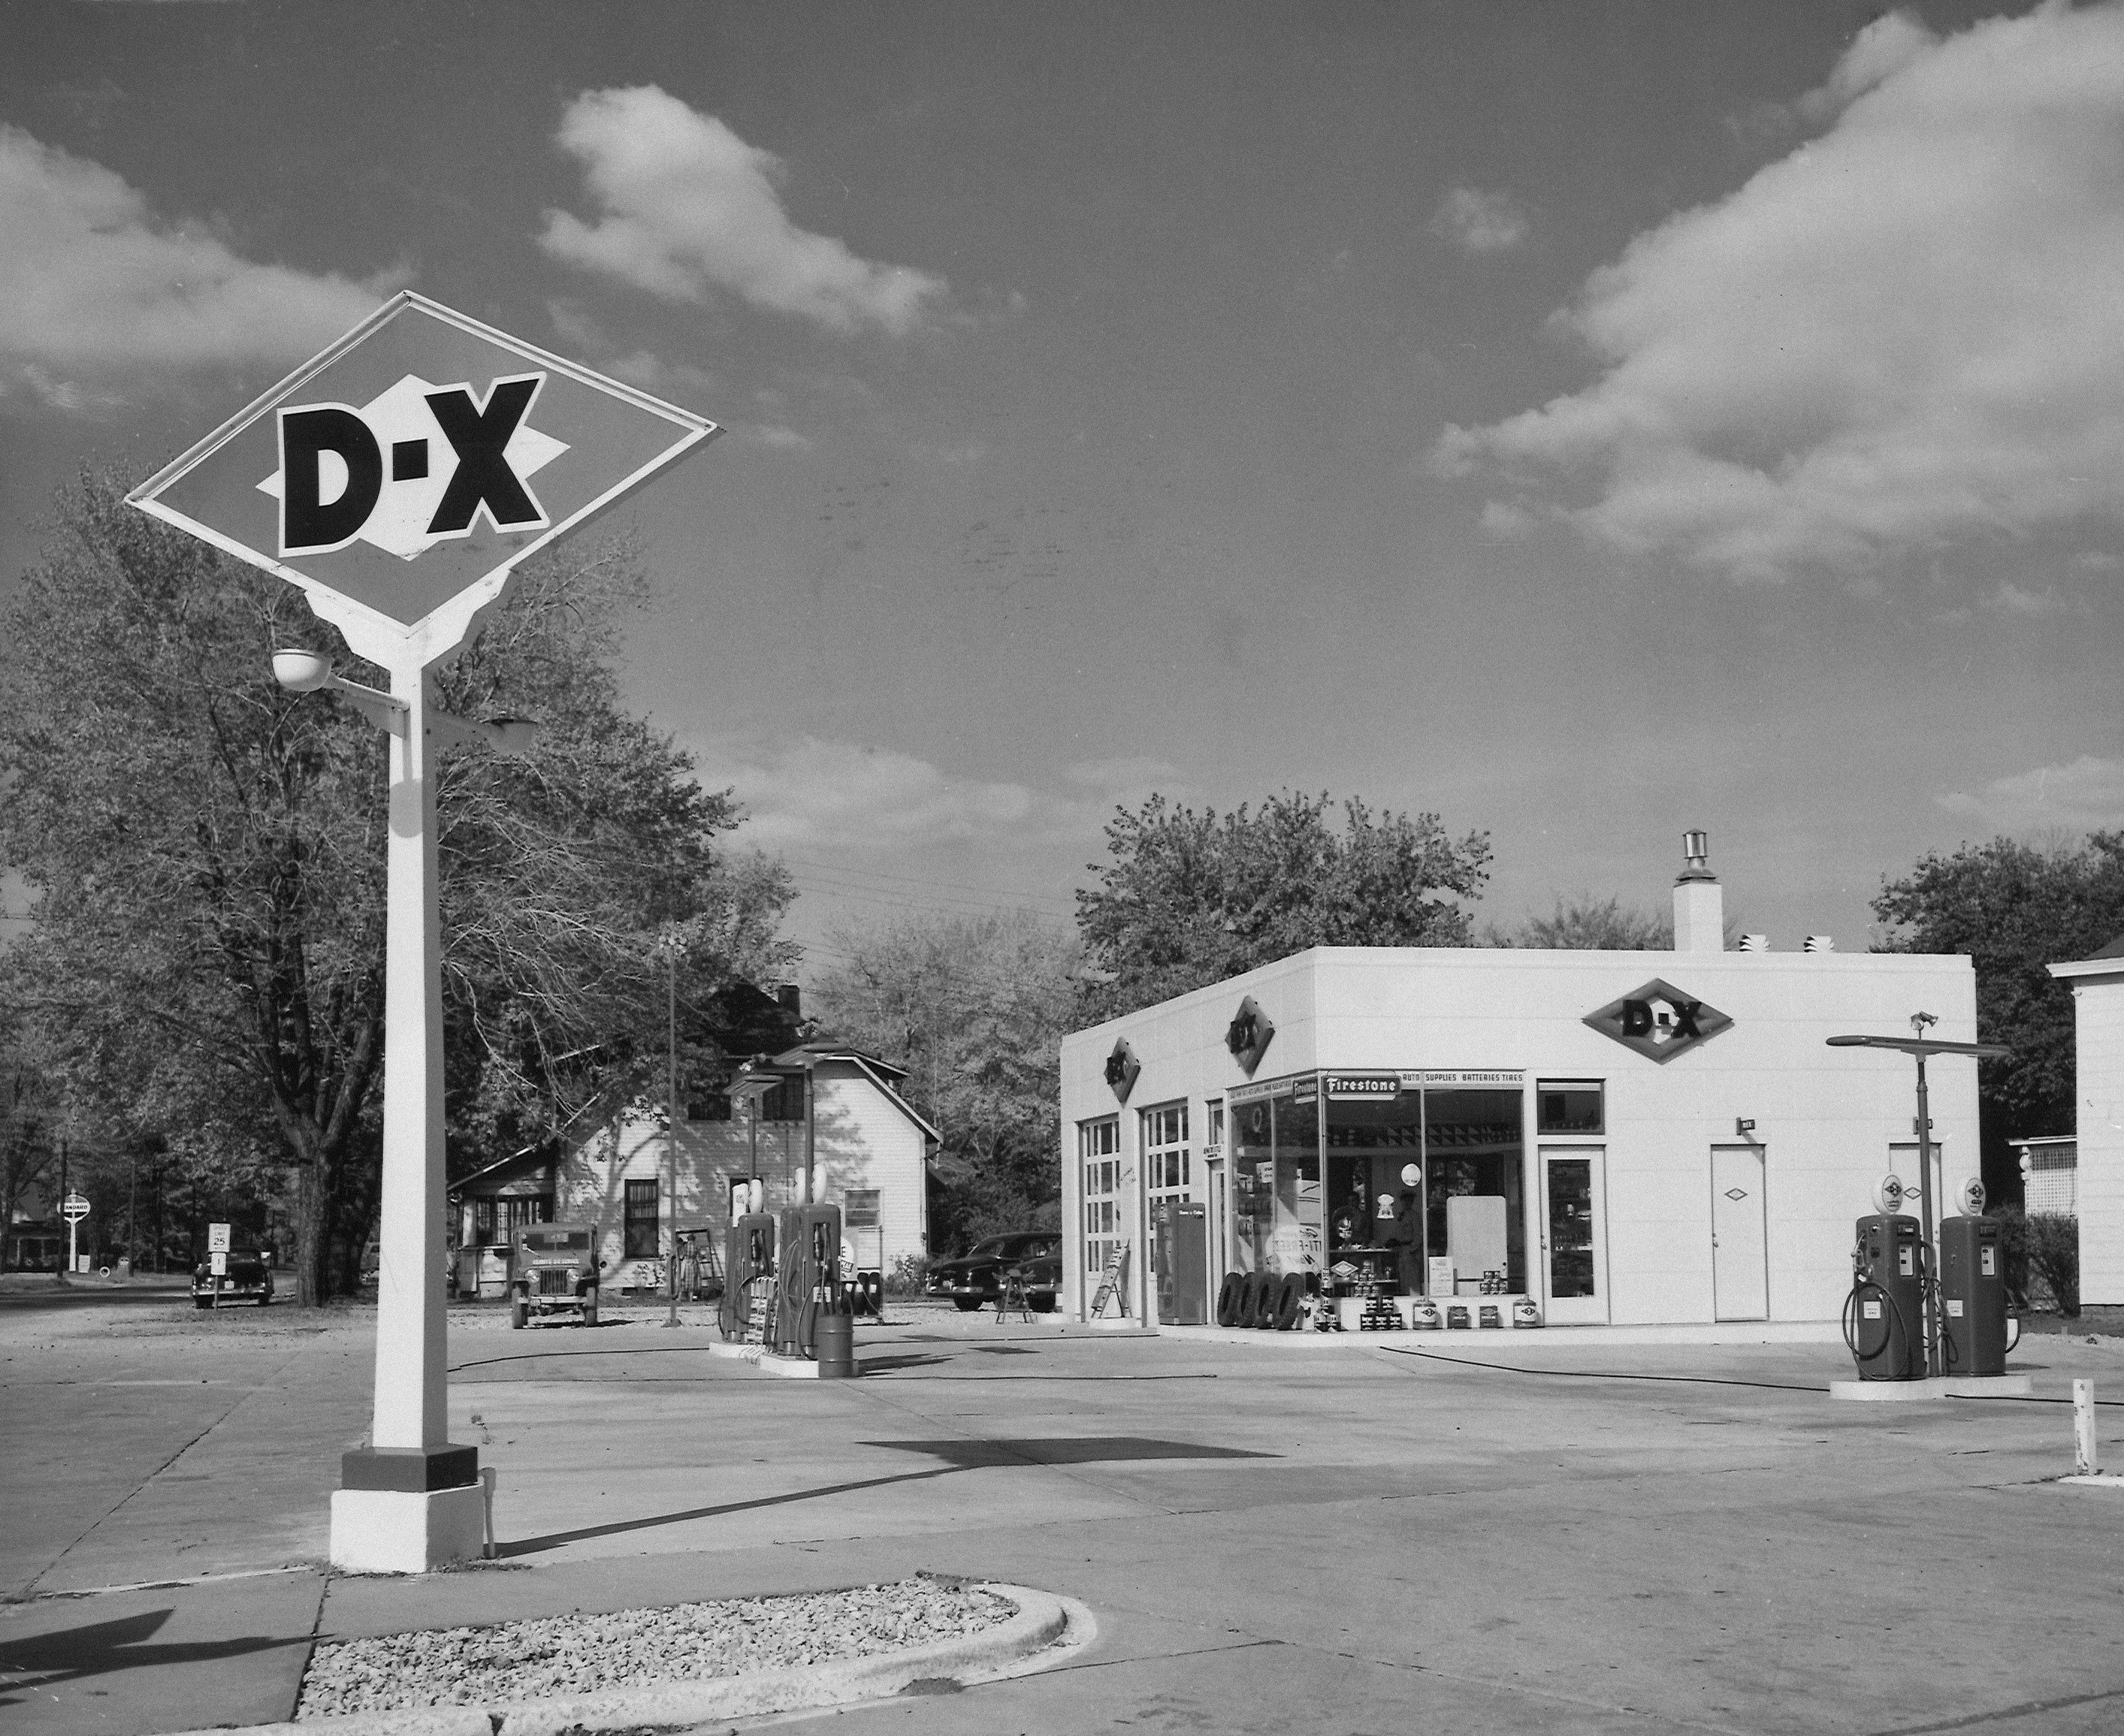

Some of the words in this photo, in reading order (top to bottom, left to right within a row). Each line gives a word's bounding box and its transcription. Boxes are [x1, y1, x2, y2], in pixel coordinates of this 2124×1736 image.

[282, 378, 543, 549] D-X
[1623, 1000, 1702, 1039] D-X
[1403, 1073, 1419, 1082] AUTO
[1425, 1073, 1457, 1082] SUPPLIES
[1462, 1073, 1500, 1082] BATTERIES
[1503, 1073, 1523, 1082] TIRES
[1326, 1078, 1396, 1091] Firestone
[214, 1237, 225, 1245] 25
